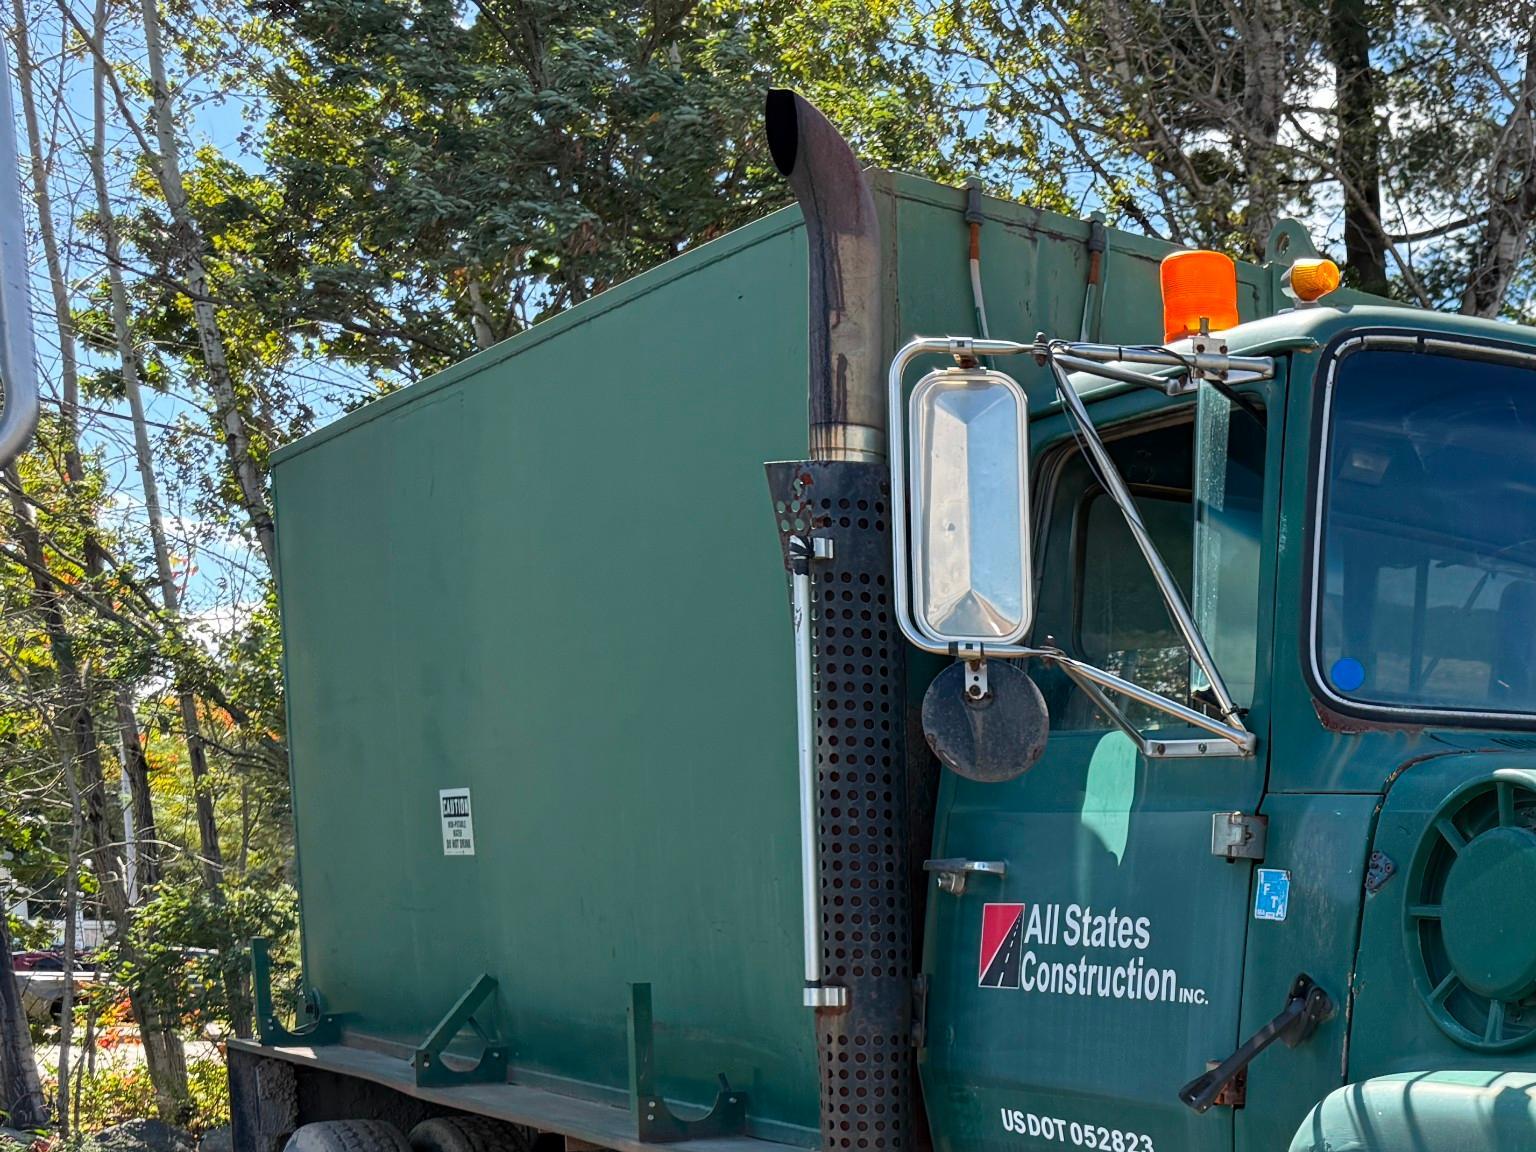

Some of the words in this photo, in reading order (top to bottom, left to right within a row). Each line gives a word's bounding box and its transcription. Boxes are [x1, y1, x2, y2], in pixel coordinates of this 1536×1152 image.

[1024, 903, 1060, 945] All
[1063, 903, 1151, 949] States
[1021, 950, 1177, 1002] Construction
[1178, 987, 1209, 1005] INC.
